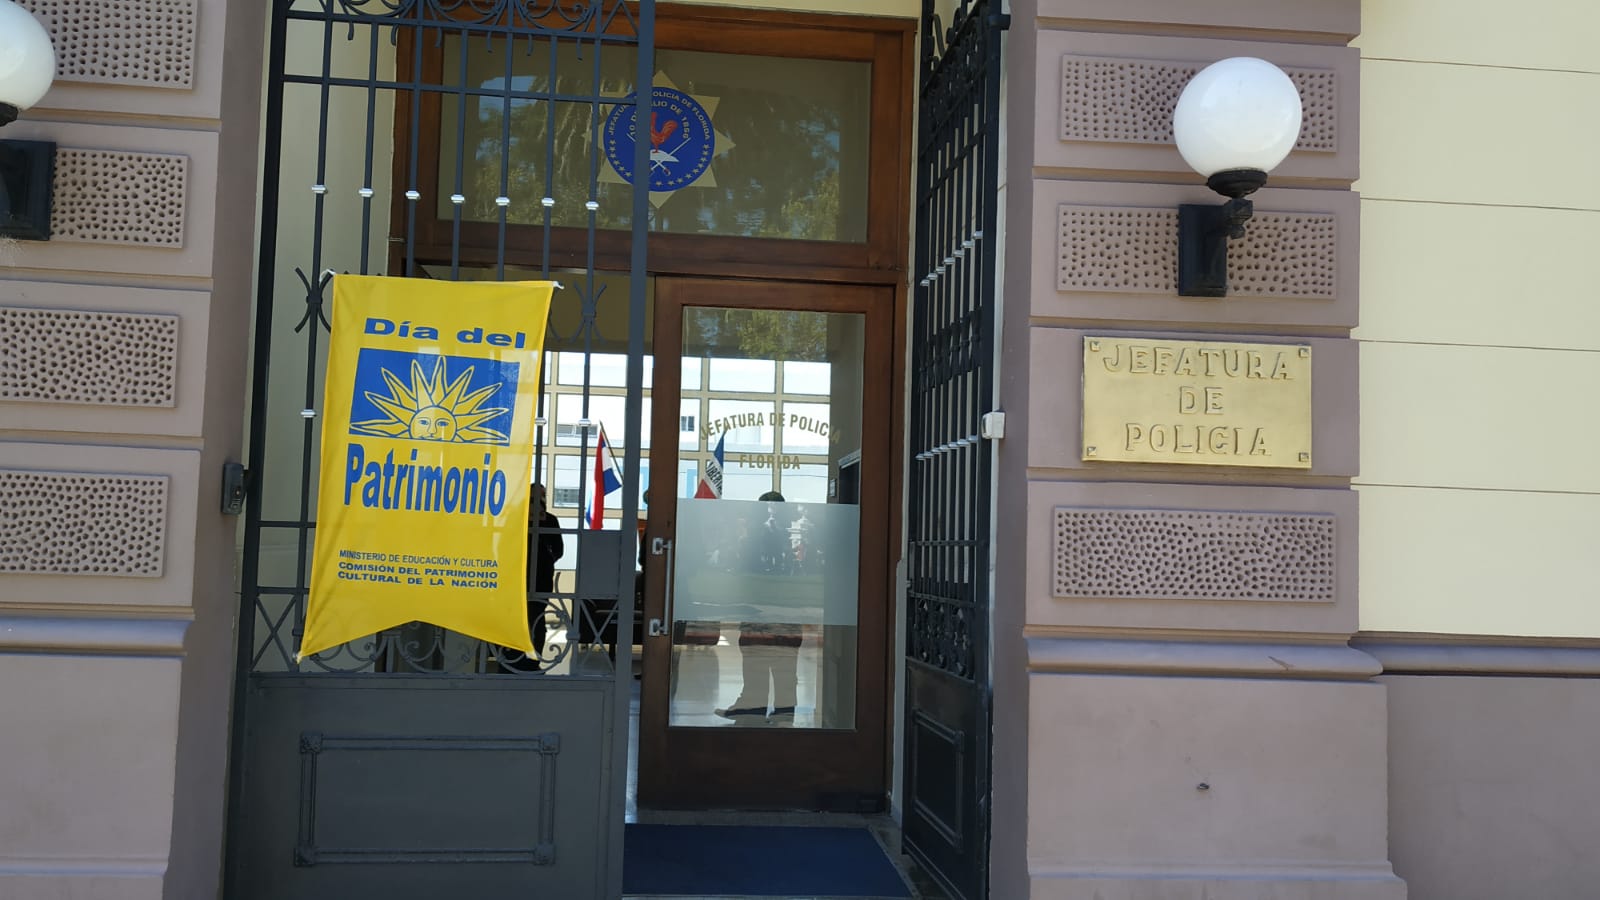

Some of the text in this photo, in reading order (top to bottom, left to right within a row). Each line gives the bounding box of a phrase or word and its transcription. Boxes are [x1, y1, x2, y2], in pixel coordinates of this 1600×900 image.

[653, 91, 680, 102] OLICIA
[681, 98, 694, 109] DE
[691, 107, 711, 140] FLORIDA
[670, 104, 683, 115] DE
[364, 317, 526, 349] Día del
[1103, 344, 1296, 380] JEFATURA
[1178, 386, 1224, 414] DE
[701, 412, 841, 444] JEFATURA DE POLICIA
[1125, 423, 1272, 456] POLICIA
[739, 454, 801, 470] FLORIDA
[344, 443, 506, 516] Patrimonio
[338, 561, 498, 579] COMISIÓN DEL PATRIMONIO
[339, 550, 498, 568] MINISTERIO DE EDUCACIÓN Y CULTURA
[338, 571, 498, 589] CULTURAL DE LA NACIÓN
